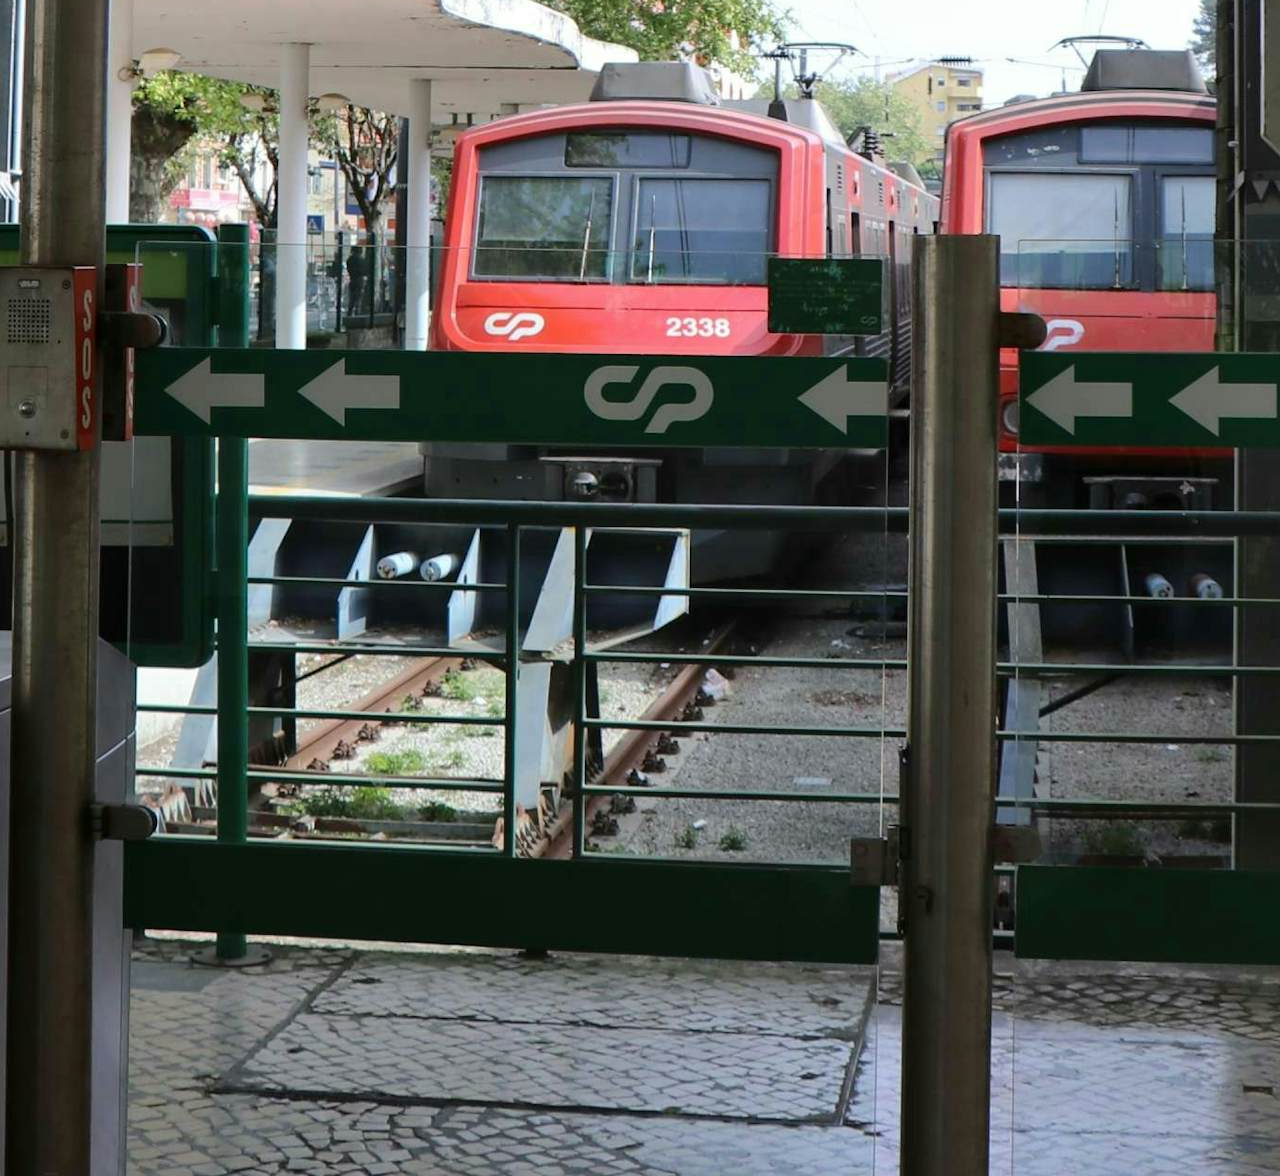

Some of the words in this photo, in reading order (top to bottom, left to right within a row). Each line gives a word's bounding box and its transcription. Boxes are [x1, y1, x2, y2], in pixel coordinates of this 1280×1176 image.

[484, 312, 544, 340] CP
[666, 317, 731, 339] 2338
[1044, 319, 1085, 351] P
[82, 289, 93, 430] SOS
[584, 365, 714, 434] CP
